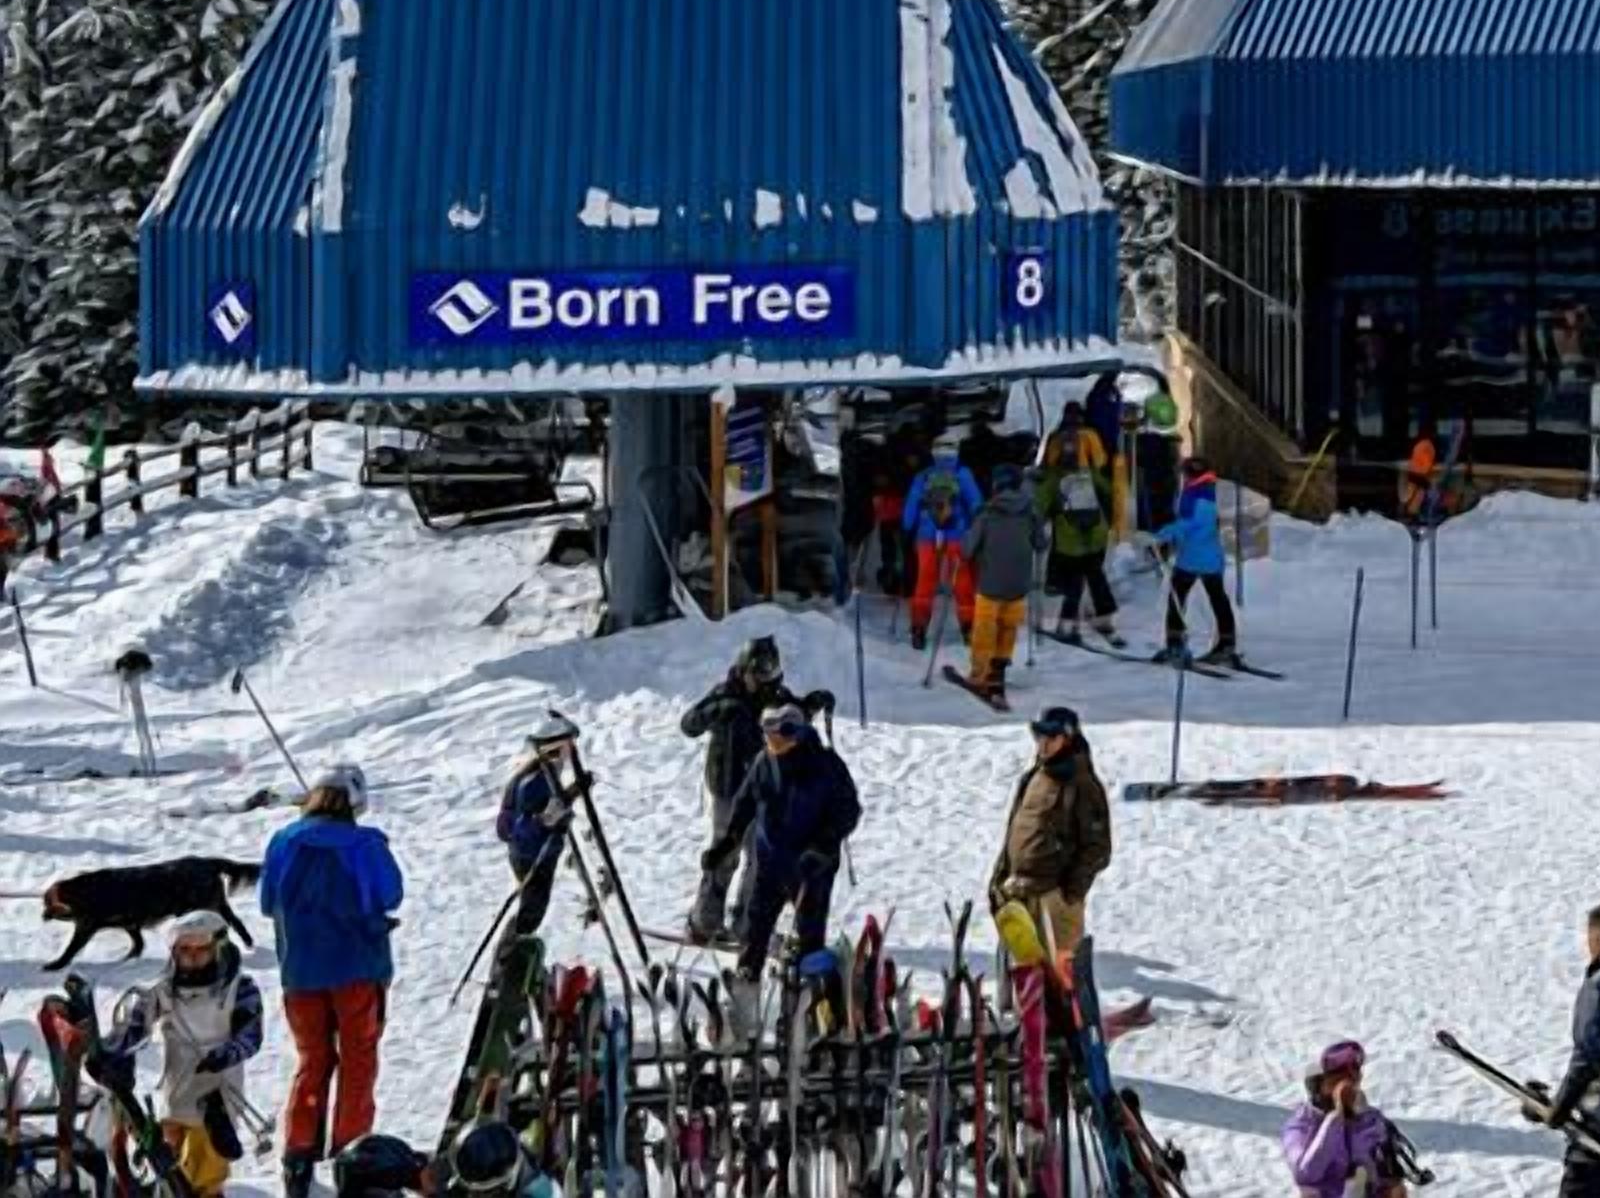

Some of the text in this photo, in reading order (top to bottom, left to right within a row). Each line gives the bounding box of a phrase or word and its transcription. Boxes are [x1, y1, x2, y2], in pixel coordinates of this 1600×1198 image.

[509, 274, 832, 329] Born Free
[1016, 258, 1043, 307] 8
